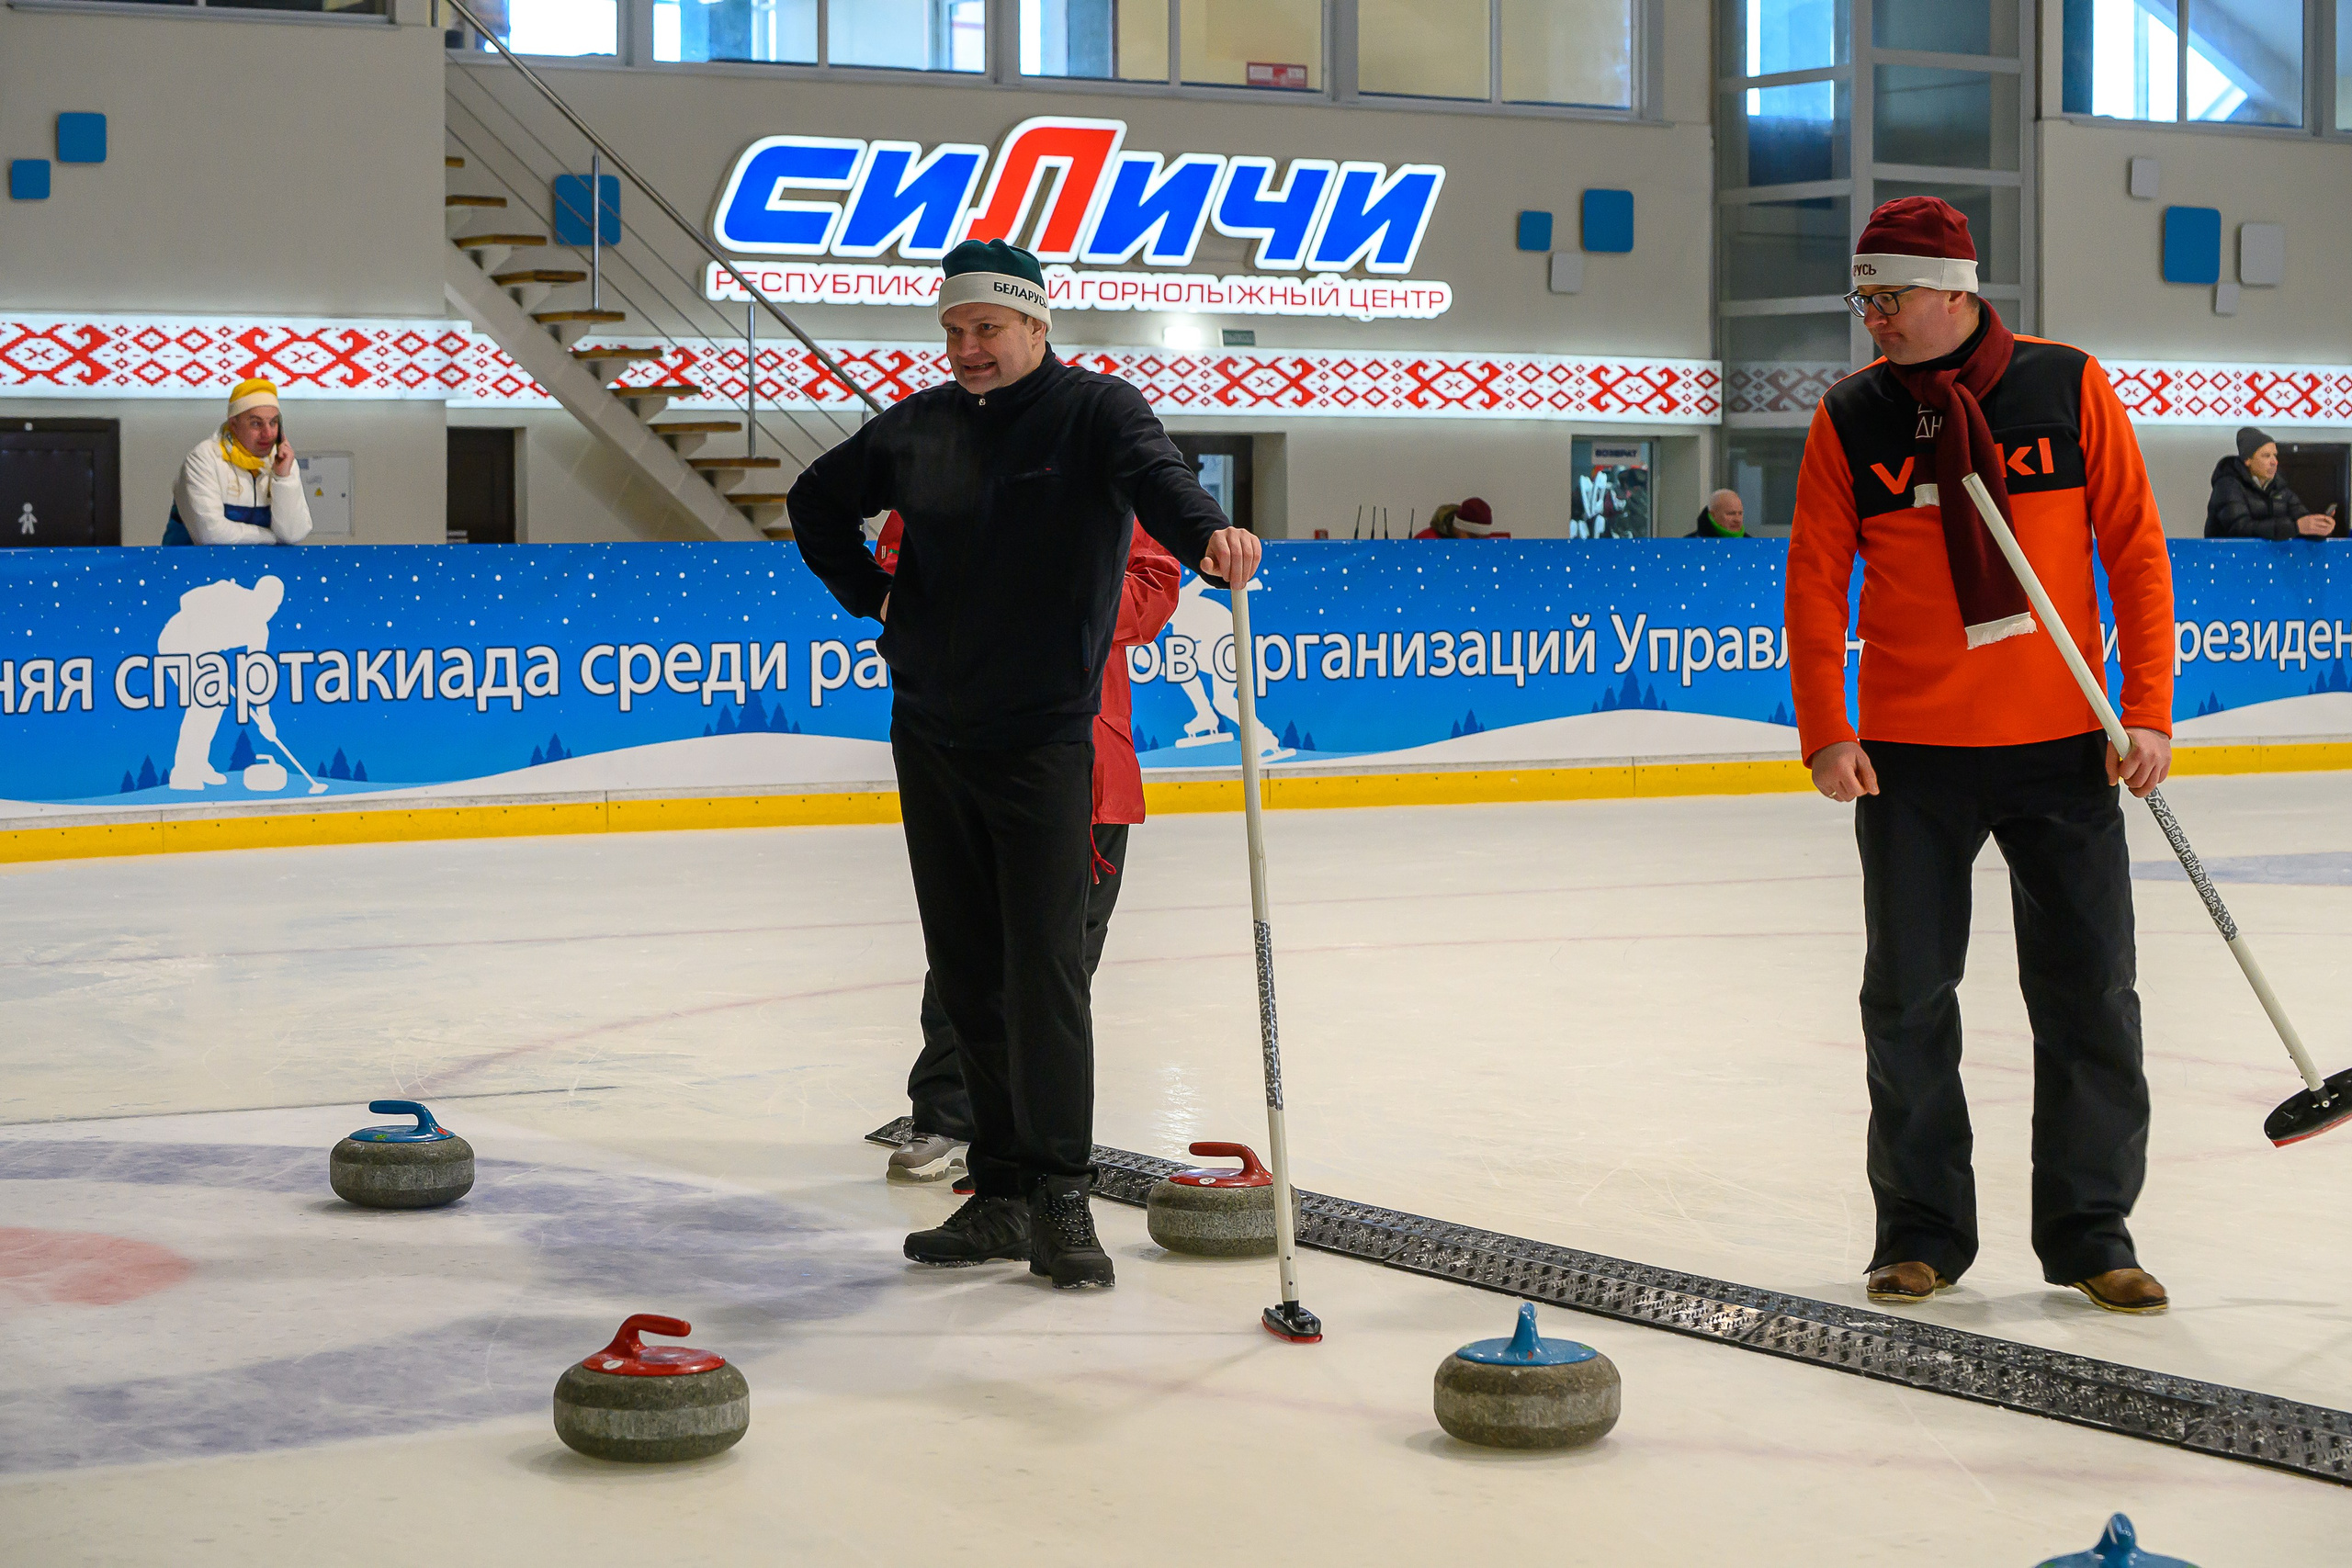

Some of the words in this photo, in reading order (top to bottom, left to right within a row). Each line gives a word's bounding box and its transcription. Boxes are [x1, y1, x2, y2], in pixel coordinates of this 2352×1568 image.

[993, 280, 1048, 310] БЕЛАРУСЬ
[1080, 279, 1340, 307] ГОРНОЛЫЖНЫЙ
[1349, 287, 1445, 313] ЦЕНТР
[114, 643, 560, 725] спартакиада
[580, 639, 788, 712] среди
[1212, 614, 1597, 698] организаций
